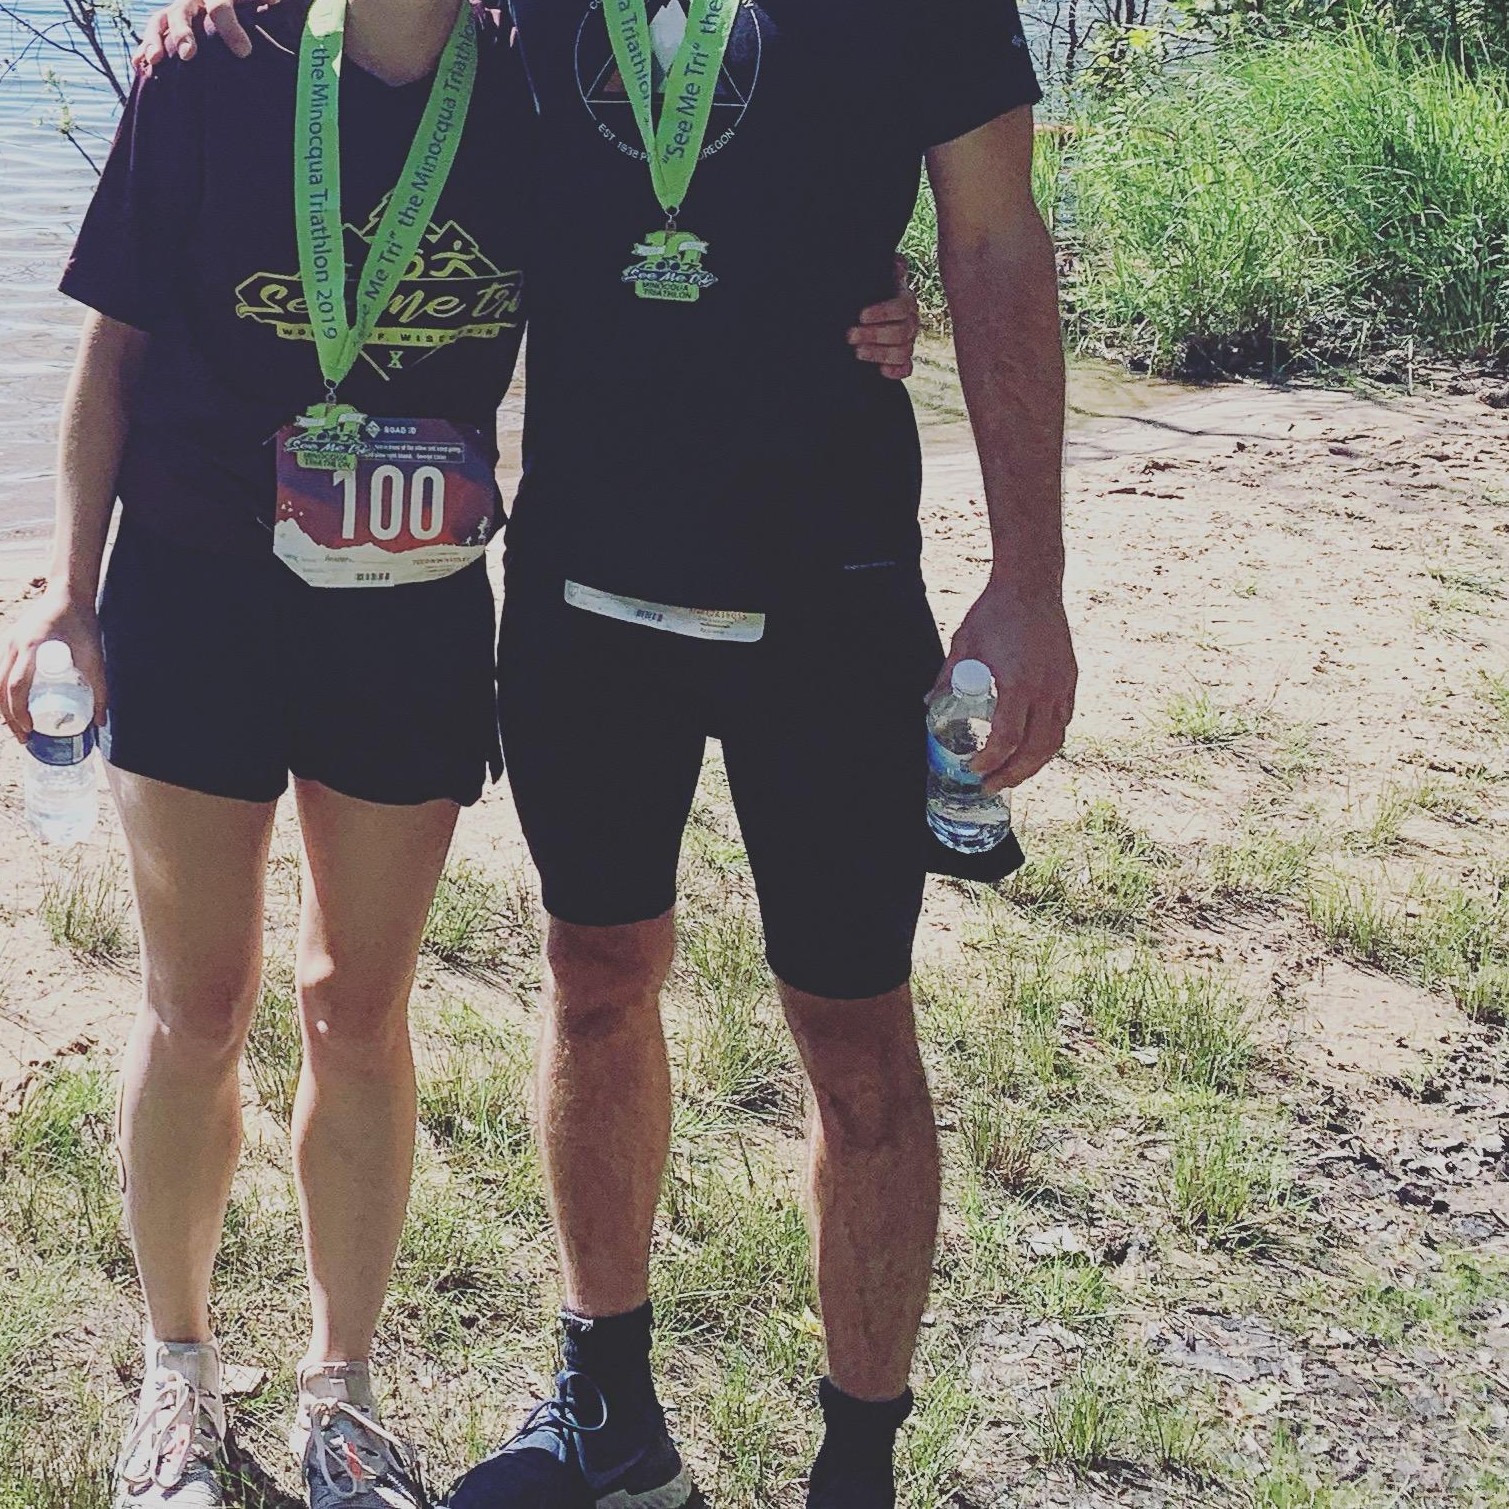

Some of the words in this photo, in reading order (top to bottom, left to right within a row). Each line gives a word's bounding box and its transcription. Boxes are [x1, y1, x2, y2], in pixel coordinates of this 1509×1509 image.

[311, 48, 330, 80] the
[676, 82, 701, 117] Me
[699, 1, 723, 34] the
[305, 84, 329, 186] Minocqua
[598, 123, 616, 141] EST
[309, 188, 332, 283] Triathlon
[365, 268, 389, 300] Me
[398, 195, 424, 228] the
[411, 97, 457, 192] Minocqua
[236, 284, 308, 317] Se
[316, 290, 338, 340] 2019
[333, 464, 445, 541] 100
